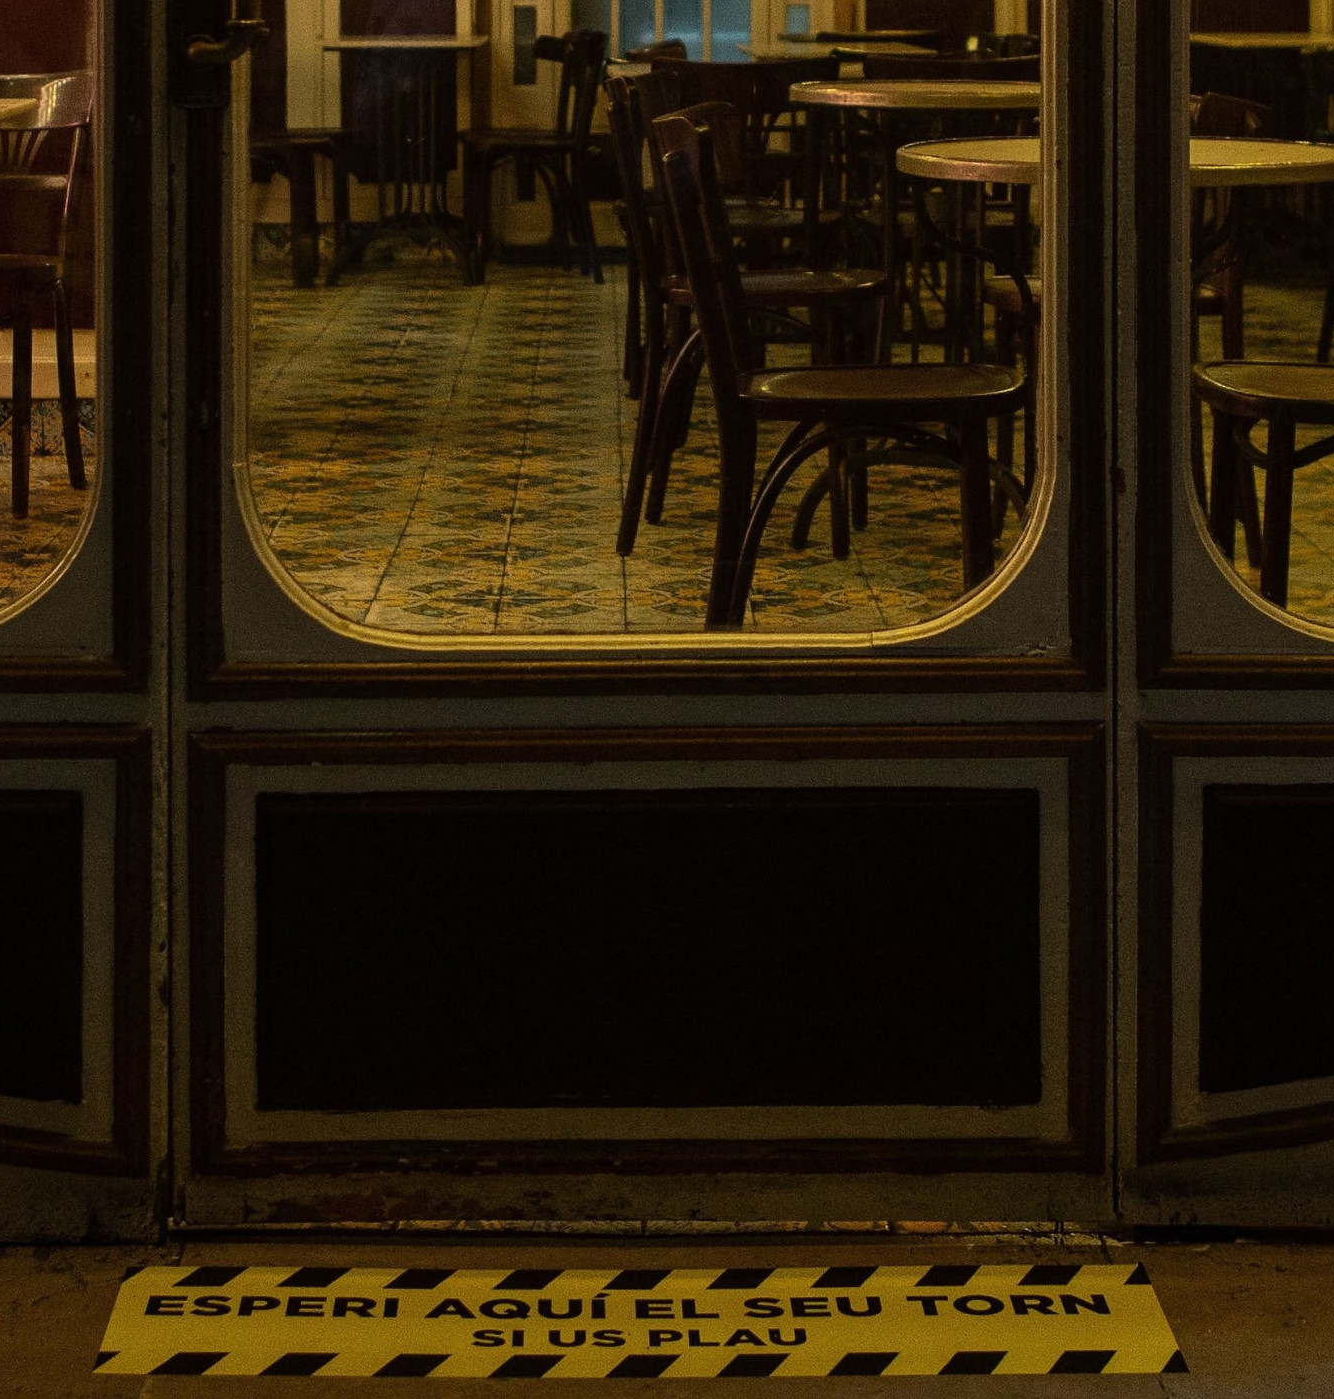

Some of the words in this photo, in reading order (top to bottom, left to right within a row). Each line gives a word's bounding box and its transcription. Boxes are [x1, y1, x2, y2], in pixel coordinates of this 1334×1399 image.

[144, 1295, 399, 1319] ESPERI
[424, 1292, 607, 1320] AQUÍ
[635, 1297, 720, 1320] EL
[744, 1295, 882, 1319] SEU
[906, 1294, 1112, 1317] TORN
[470, 1329, 523, 1347] SI
[549, 1329, 625, 1347] US
[649, 1328, 808, 1347] PLAU
